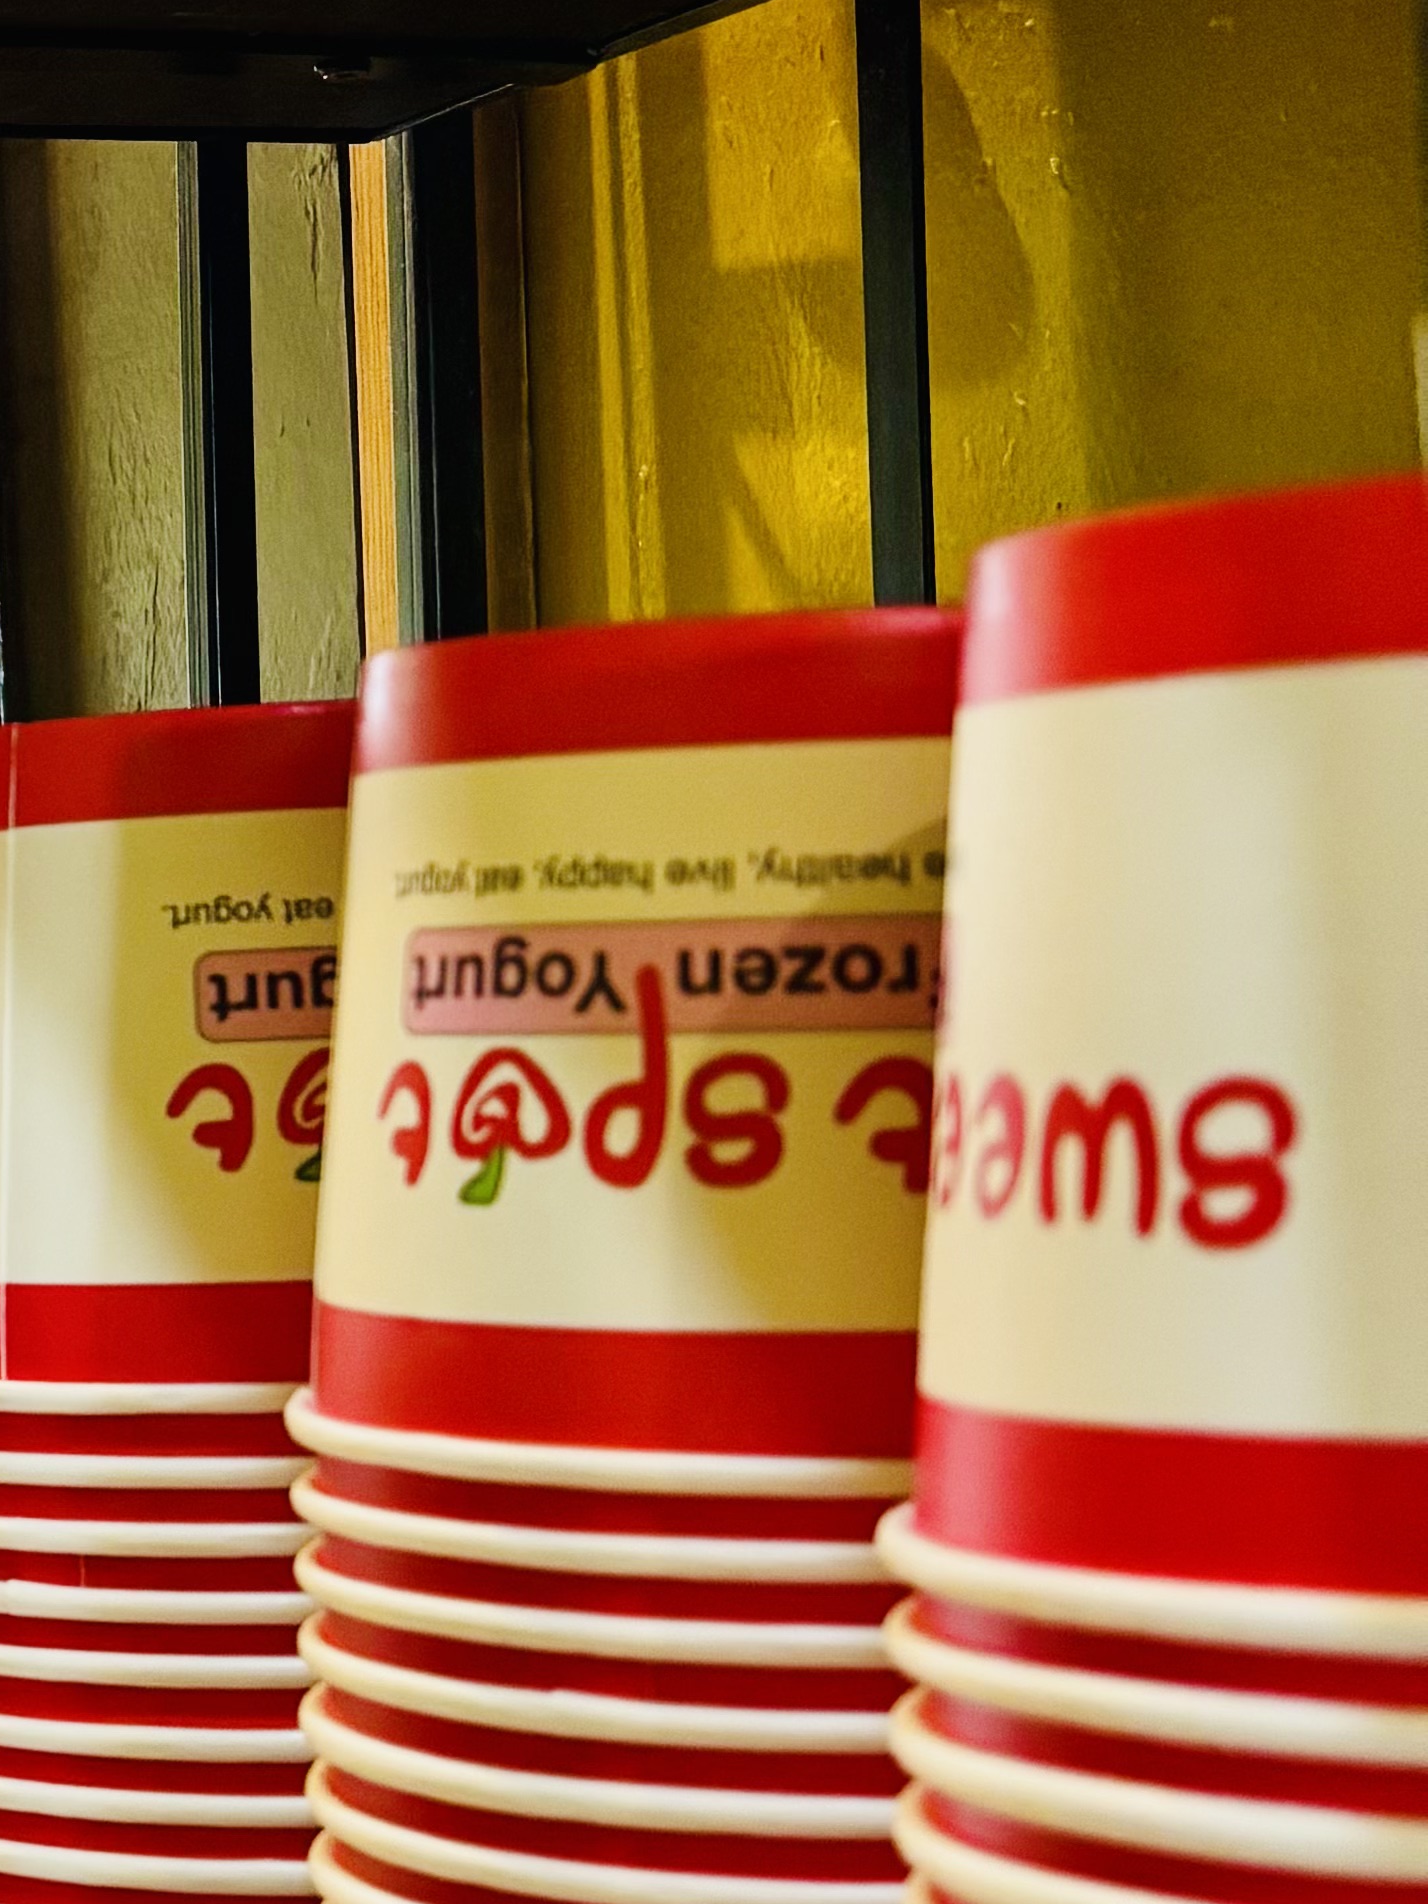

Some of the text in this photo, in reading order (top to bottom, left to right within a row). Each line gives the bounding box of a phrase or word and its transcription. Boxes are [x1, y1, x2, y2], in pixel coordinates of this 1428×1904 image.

[474, 865, 524, 899] eat
[666, 856, 736, 891] live
[161, 892, 334, 931] eat yogurt.
[208, 954, 337, 1022] gurt
[411, 938, 627, 1015] Yogurt
[931, 1074, 1298, 1254] swee
